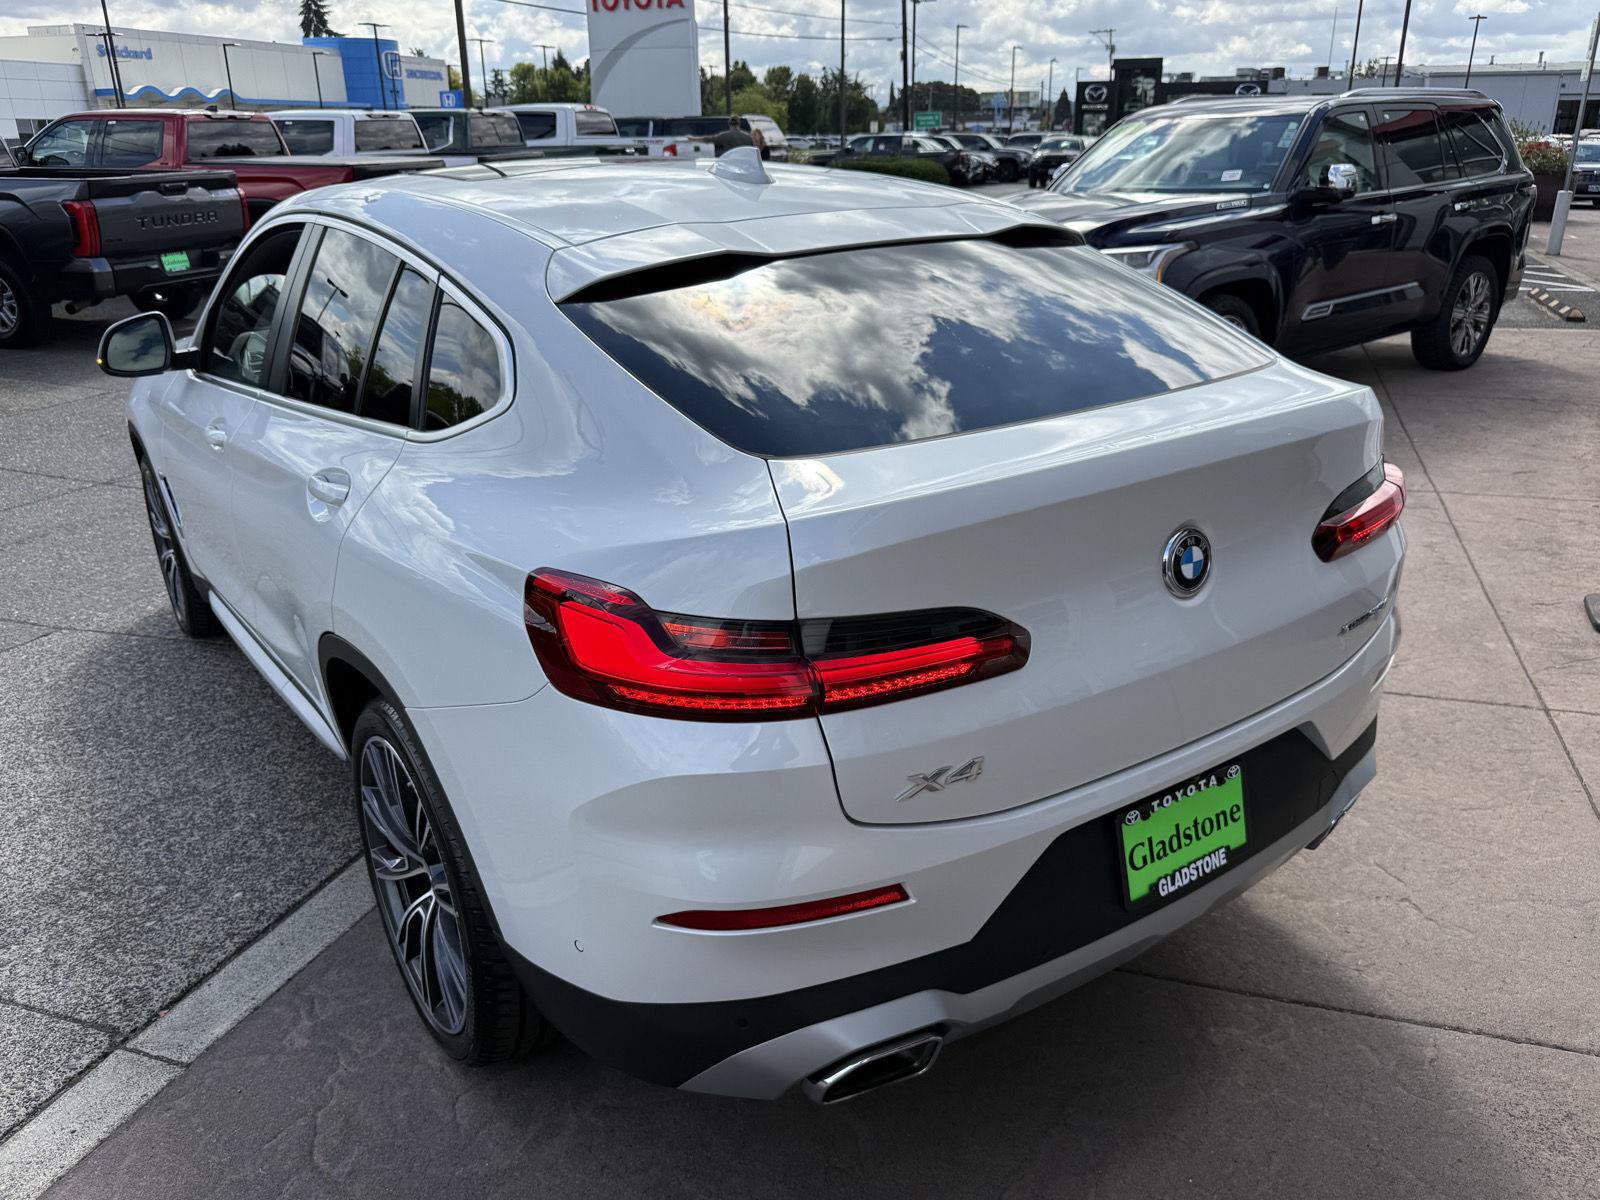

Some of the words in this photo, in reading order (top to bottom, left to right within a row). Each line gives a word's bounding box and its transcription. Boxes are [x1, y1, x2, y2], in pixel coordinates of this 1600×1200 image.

[135, 211, 218, 230] TUNDRA
[895, 755, 985, 802] X4
[1152, 774, 1218, 812] TOYOTA
[1128, 803, 1241, 871] Gladstone
[1158, 847, 1228, 897] GLADSTONE
